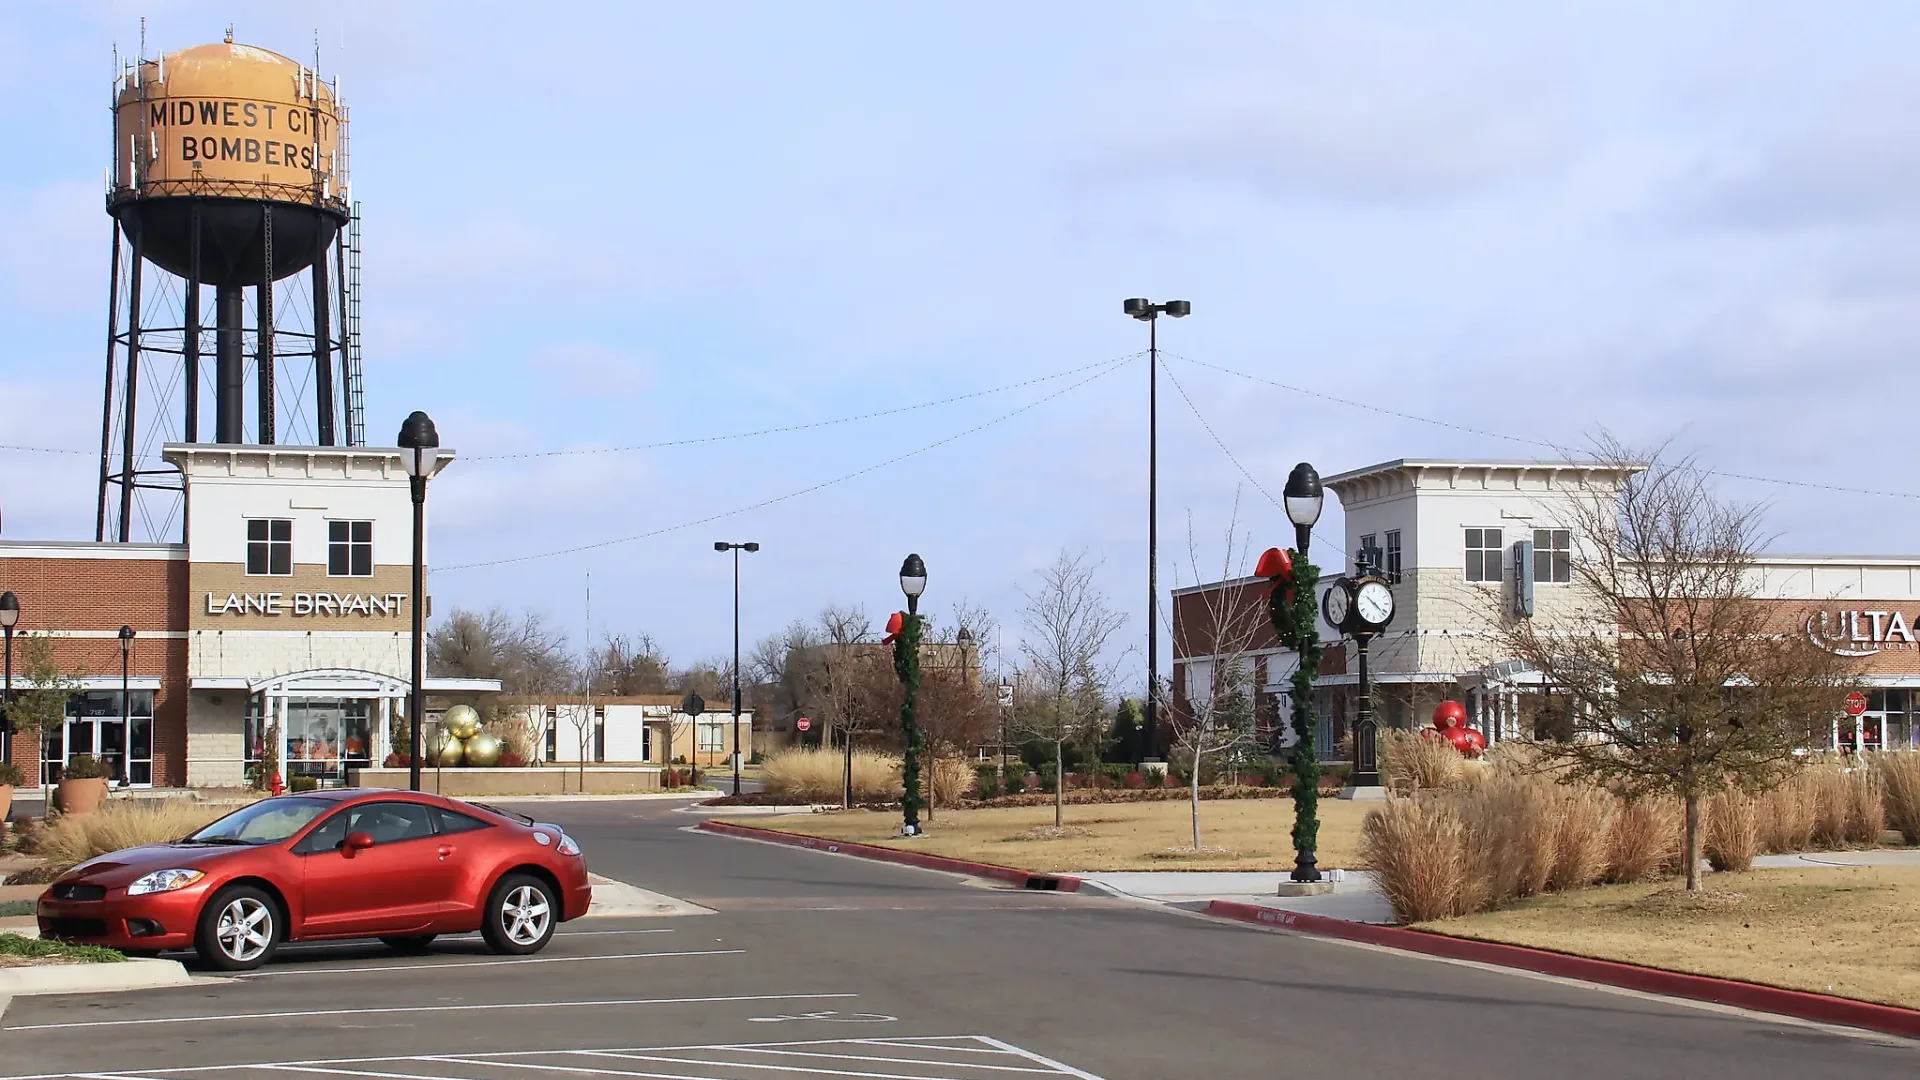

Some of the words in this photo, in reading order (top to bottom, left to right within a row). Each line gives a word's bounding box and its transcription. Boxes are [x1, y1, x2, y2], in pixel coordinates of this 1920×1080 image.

[151, 100, 277, 130] MIDWEST
[288, 108, 330, 142] CITY
[182, 136, 312, 170] BOMBERS
[1515, 547, 1523, 611] ULTA
[207, 591, 282, 615] LANE
[294, 592, 408, 616] BRYANT
[1820, 610, 1917, 642] ULTA
[1850, 642, 1915, 650] BEAUTY
[1845, 699, 1865, 709] STOP
